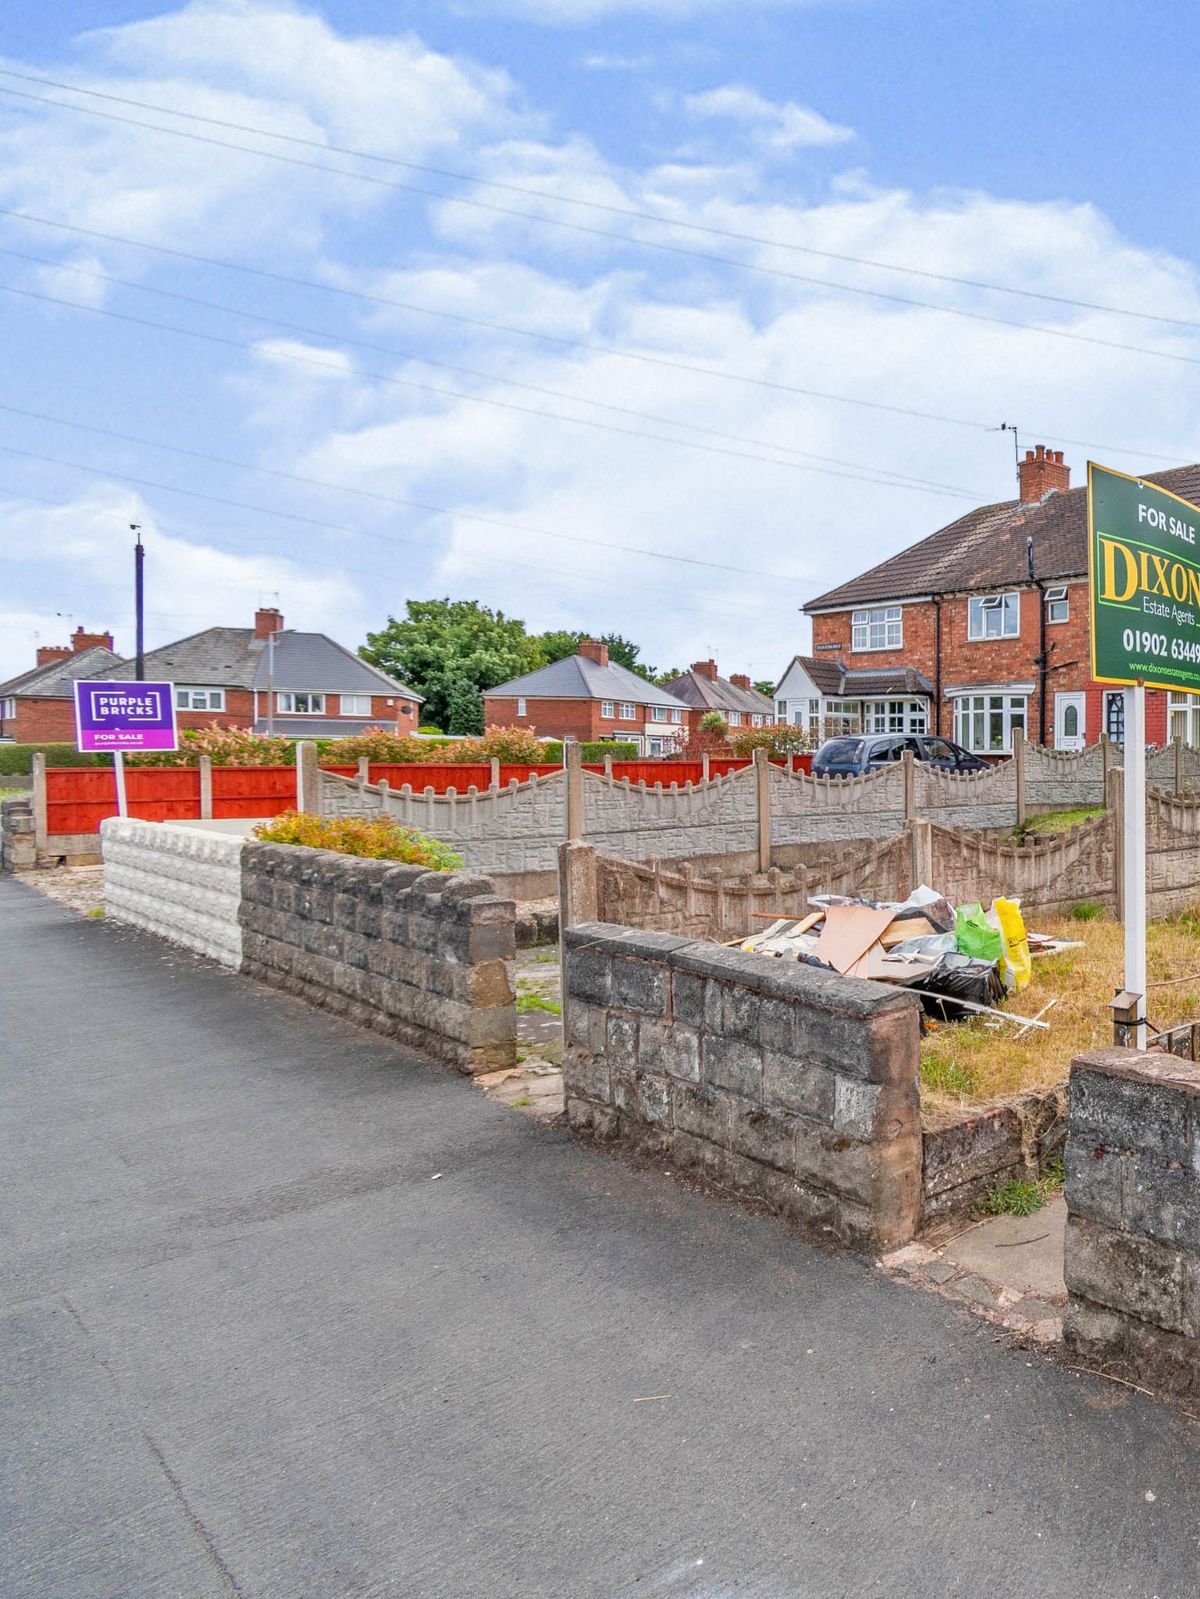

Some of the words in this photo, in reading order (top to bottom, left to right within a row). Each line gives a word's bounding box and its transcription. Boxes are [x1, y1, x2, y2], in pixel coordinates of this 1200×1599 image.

[1138, 503, 1167, 532] FOR
[1169, 517, 1195, 544] SALE
[1143, 596, 1170, 617] Estate
[1171, 609, 1195, 626] Agents
[1122, 628, 1168, 657] 01902
[100, 697, 153, 706] PURPLE
[101, 706, 153, 715] BRICKS
